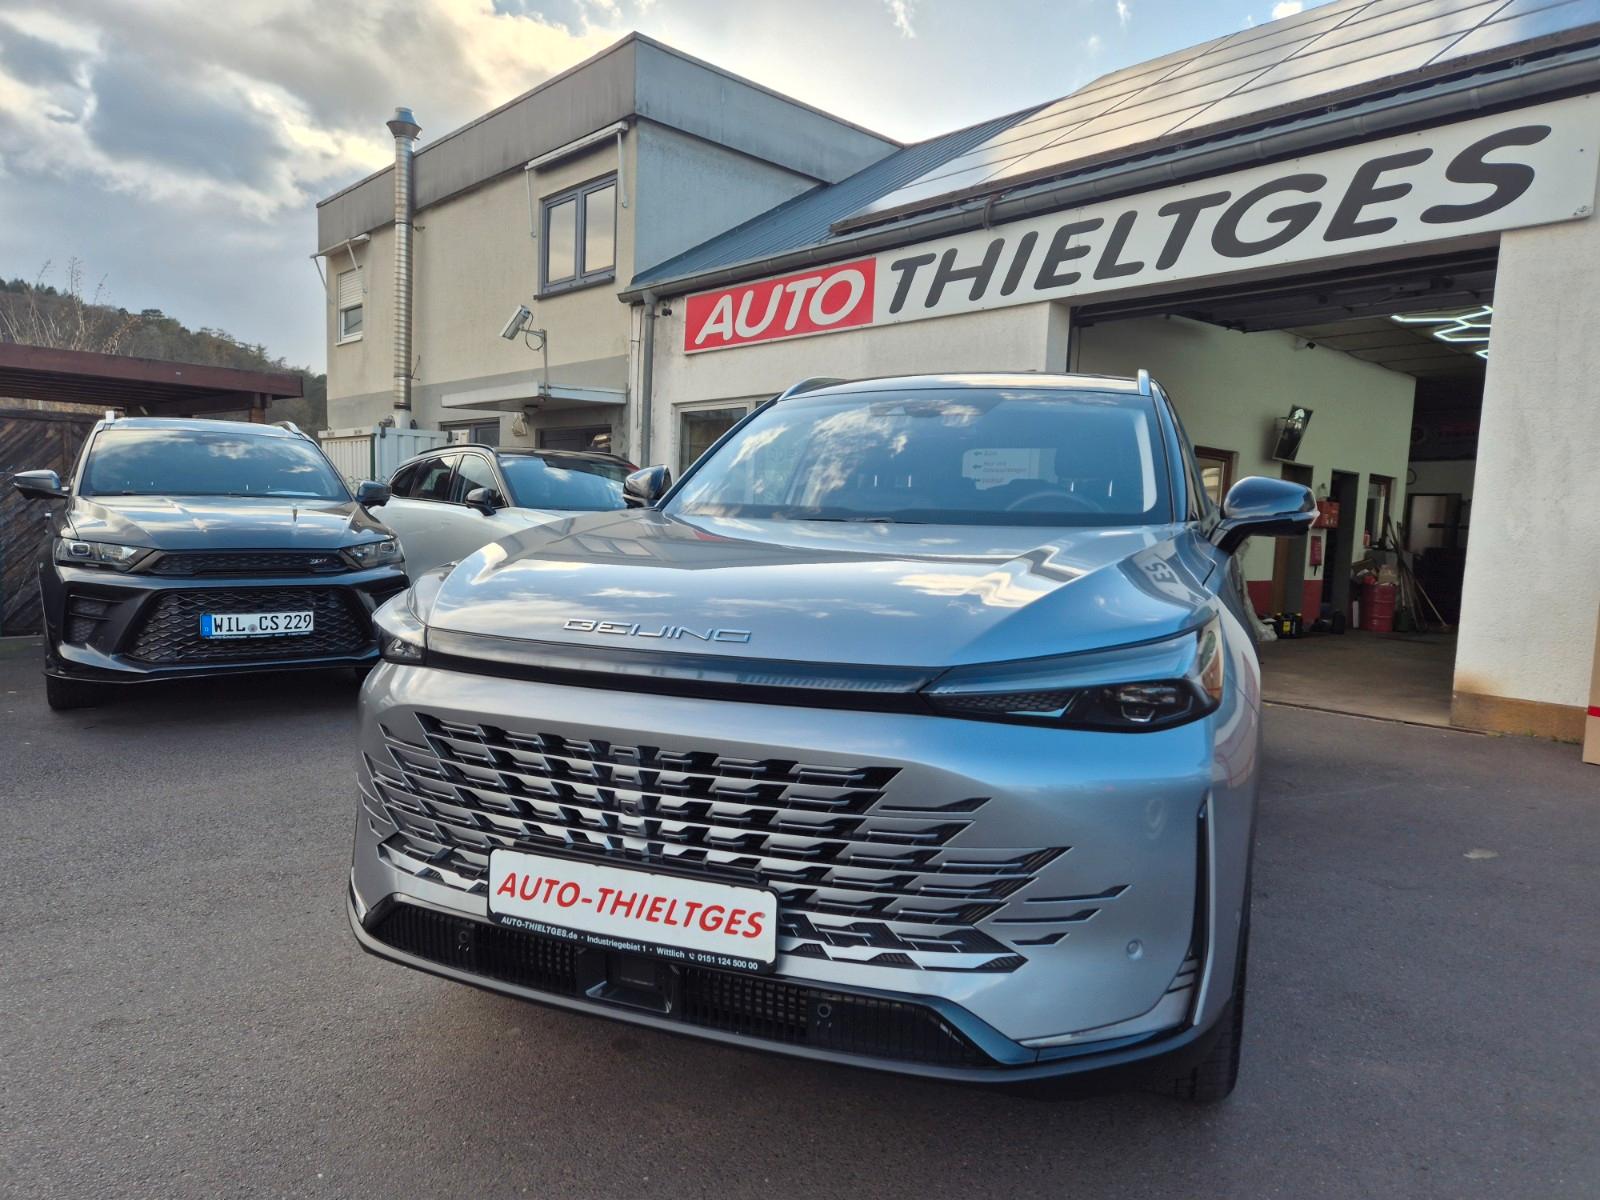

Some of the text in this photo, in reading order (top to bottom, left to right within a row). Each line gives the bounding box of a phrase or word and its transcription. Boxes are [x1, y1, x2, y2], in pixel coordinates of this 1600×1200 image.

[694, 124, 1552, 346] AUTO THIELTGES
[214, 617, 246, 633] WIL
[259, 615, 279, 631] CS
[284, 614, 312, 630] 229
[563, 618, 752, 643] BEIJING
[497, 872, 766, 938] AUTO-THIELTGES
[501, 916, 578, 940] AUTO-THIELTGES.de
[587, 935, 640, 952] Industriegebiet
[656, 947, 685, 959] Wittlich
[698, 954, 715, 963] 0151
[717, 957, 731, 966] 124
[733, 960, 746, 969] 500
[748, 962, 758, 970] 00
